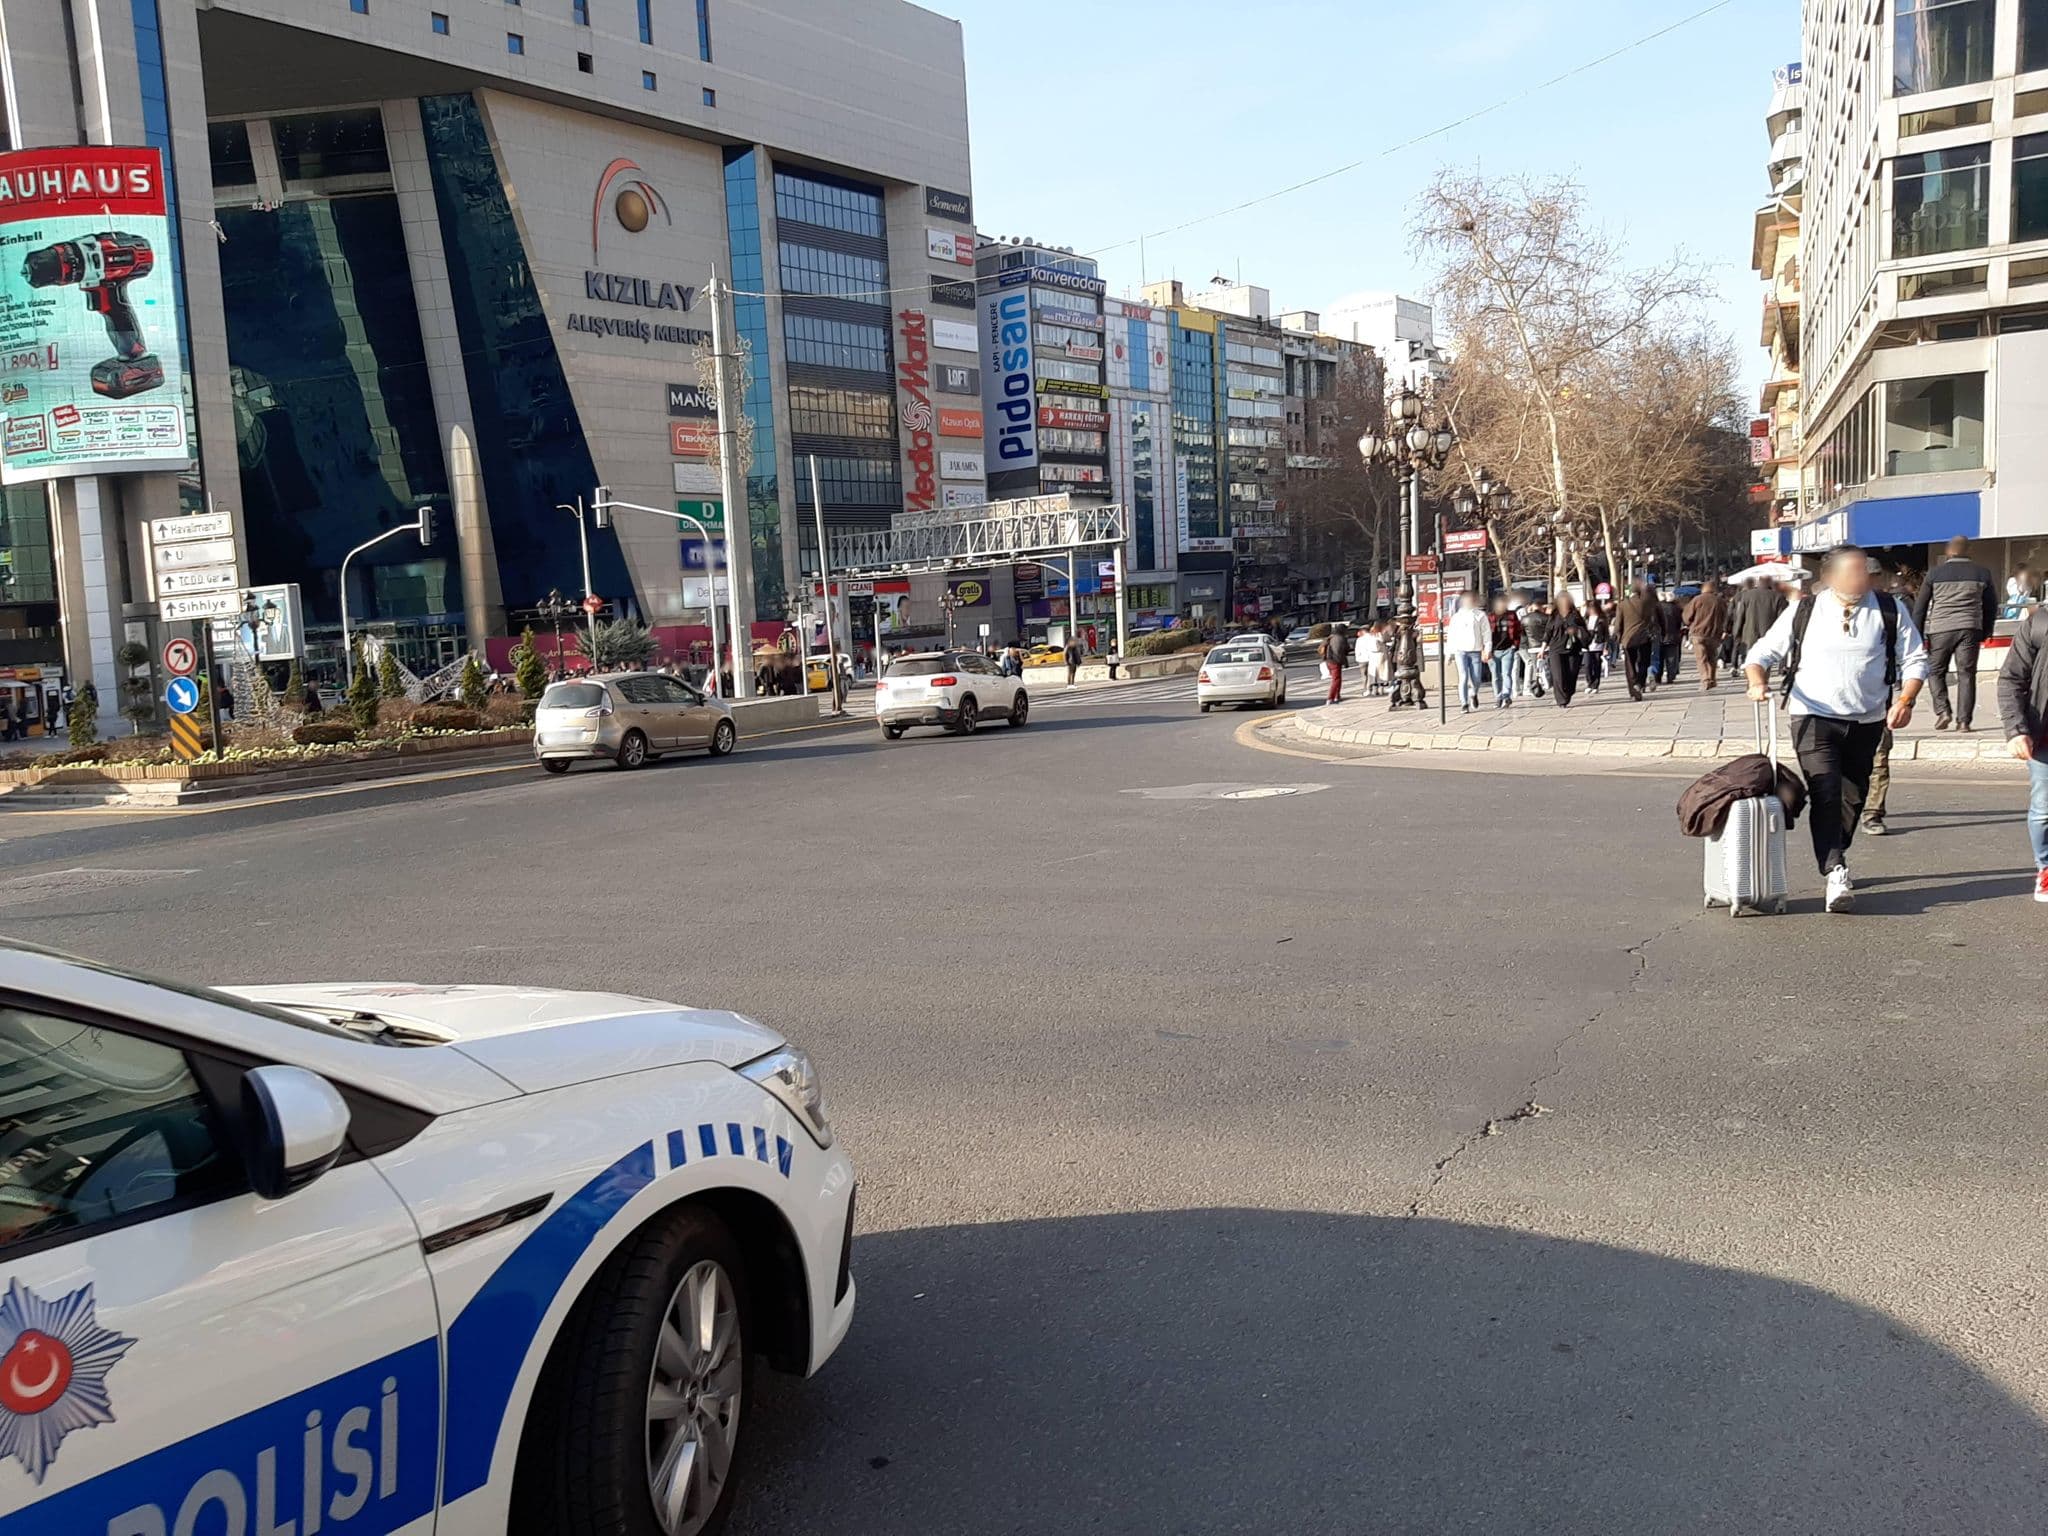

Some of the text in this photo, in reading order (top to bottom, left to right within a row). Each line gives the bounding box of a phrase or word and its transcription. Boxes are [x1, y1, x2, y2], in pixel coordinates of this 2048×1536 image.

[585, 270, 695, 312] KIZILAY
[567, 313, 713, 347] ALIŞVERİŞ MERKE
[997, 294, 1034, 460] Pidosan
[702, 502, 715, 518] D
[960, 583, 979, 597] gratis
